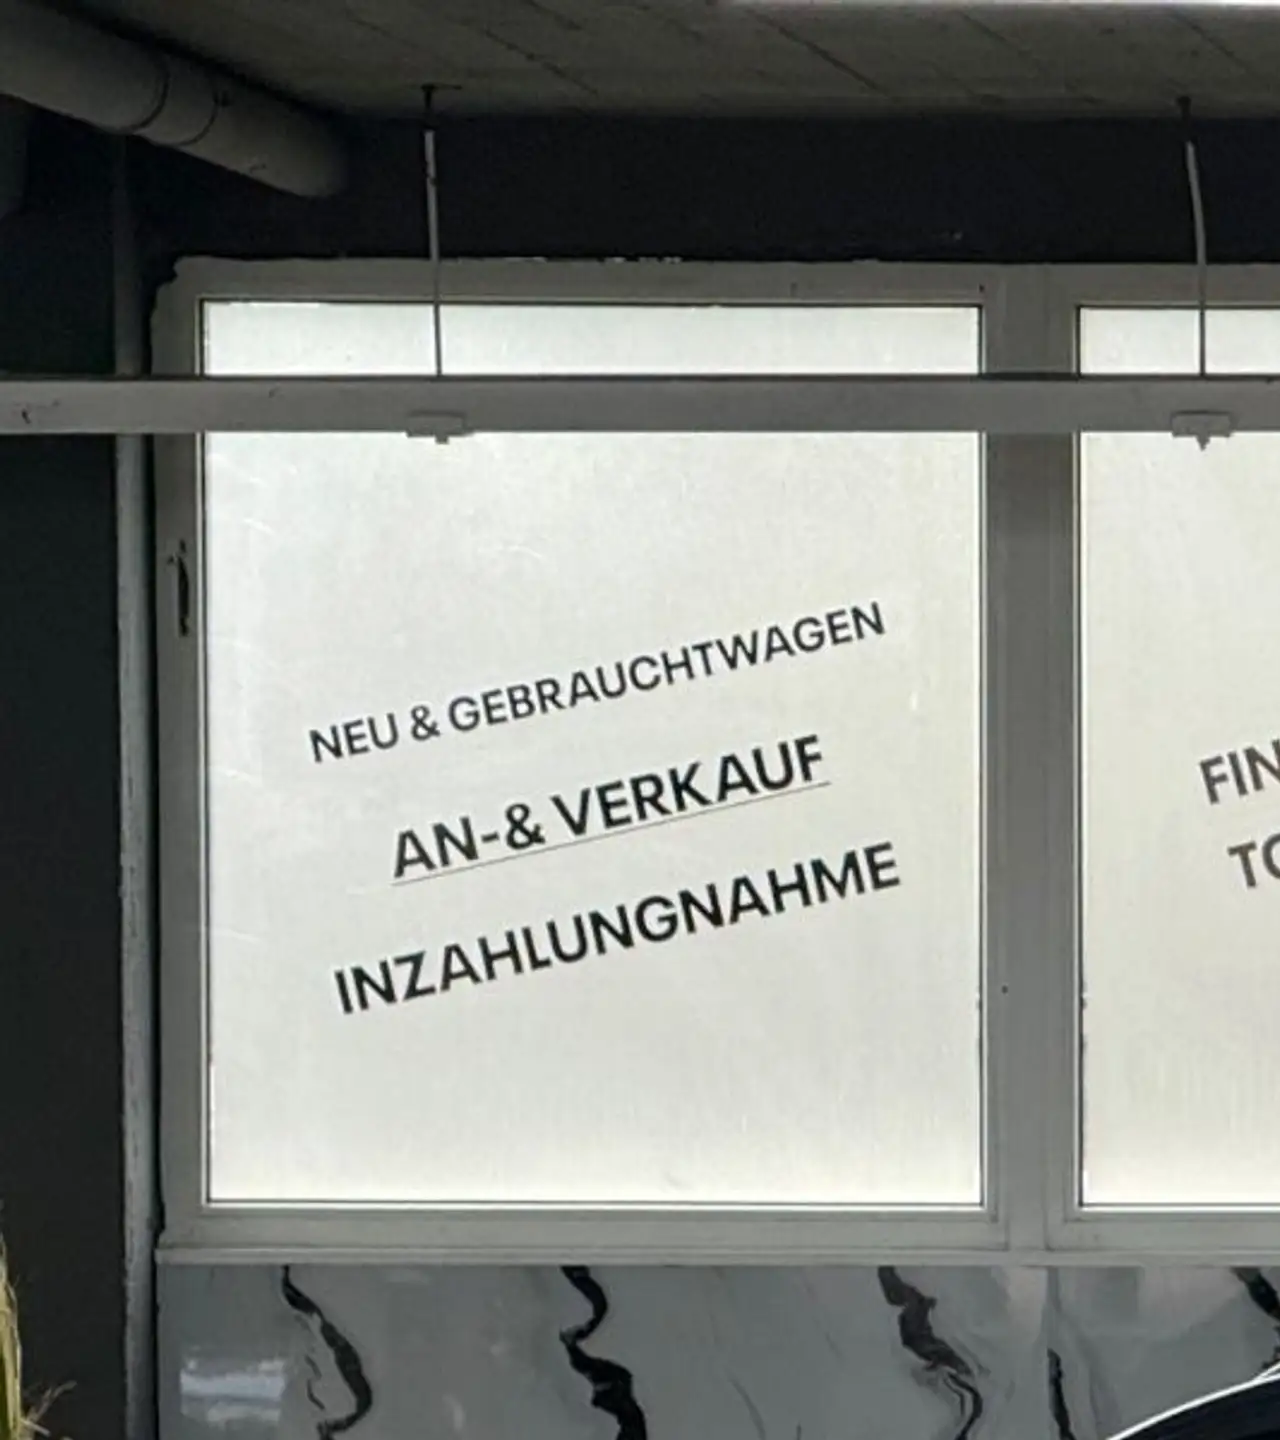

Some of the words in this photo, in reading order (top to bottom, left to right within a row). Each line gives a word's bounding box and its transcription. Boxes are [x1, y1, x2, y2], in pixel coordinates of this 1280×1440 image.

[310, 714, 398, 762] NEU
[411, 706, 440, 740] &
[449, 603, 884, 731] GEBRAUCHTWAGEN
[395, 804, 545, 877] AN-&
[551, 735, 822, 835] VERKAUF
[335, 842, 900, 1014] INZAHLUNGNAHME
